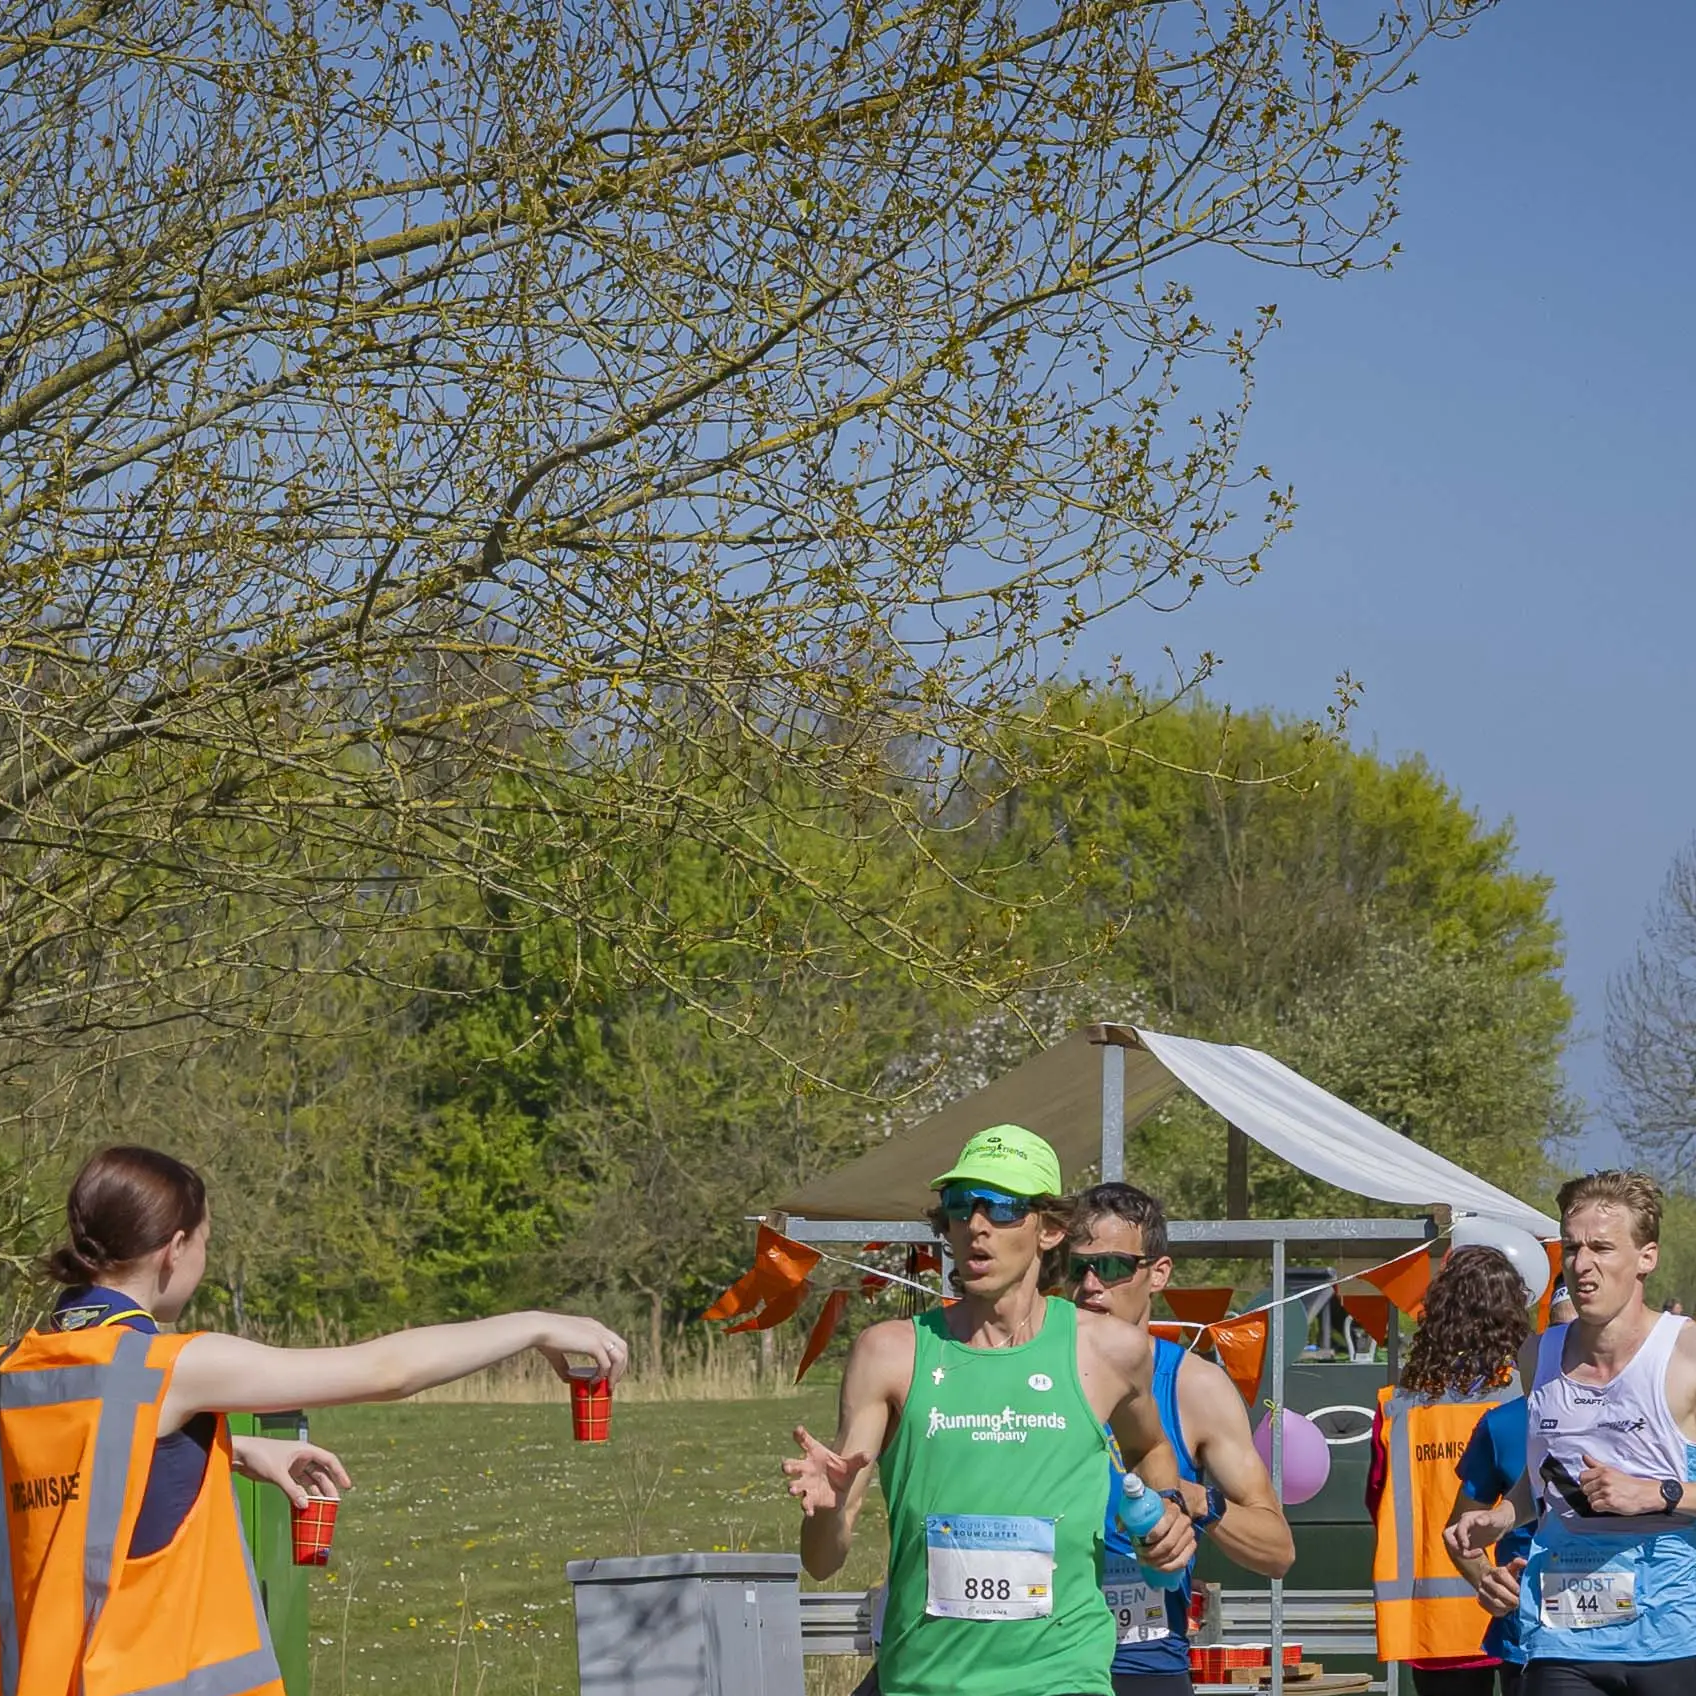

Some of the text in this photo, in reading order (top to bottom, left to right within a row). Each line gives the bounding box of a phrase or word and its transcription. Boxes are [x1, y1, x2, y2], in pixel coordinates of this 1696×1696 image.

[972, 1431, 1027, 1443] company
[1416, 1442, 1467, 1461] ORGANIS
[964, 1577, 1011, 1600] 888
[1558, 1577, 1615, 1592] JOOST
[1105, 1587, 1147, 1605] BEN
[1576, 1595, 1599, 1612] 44
[1110, 1608, 1132, 1627] 9
